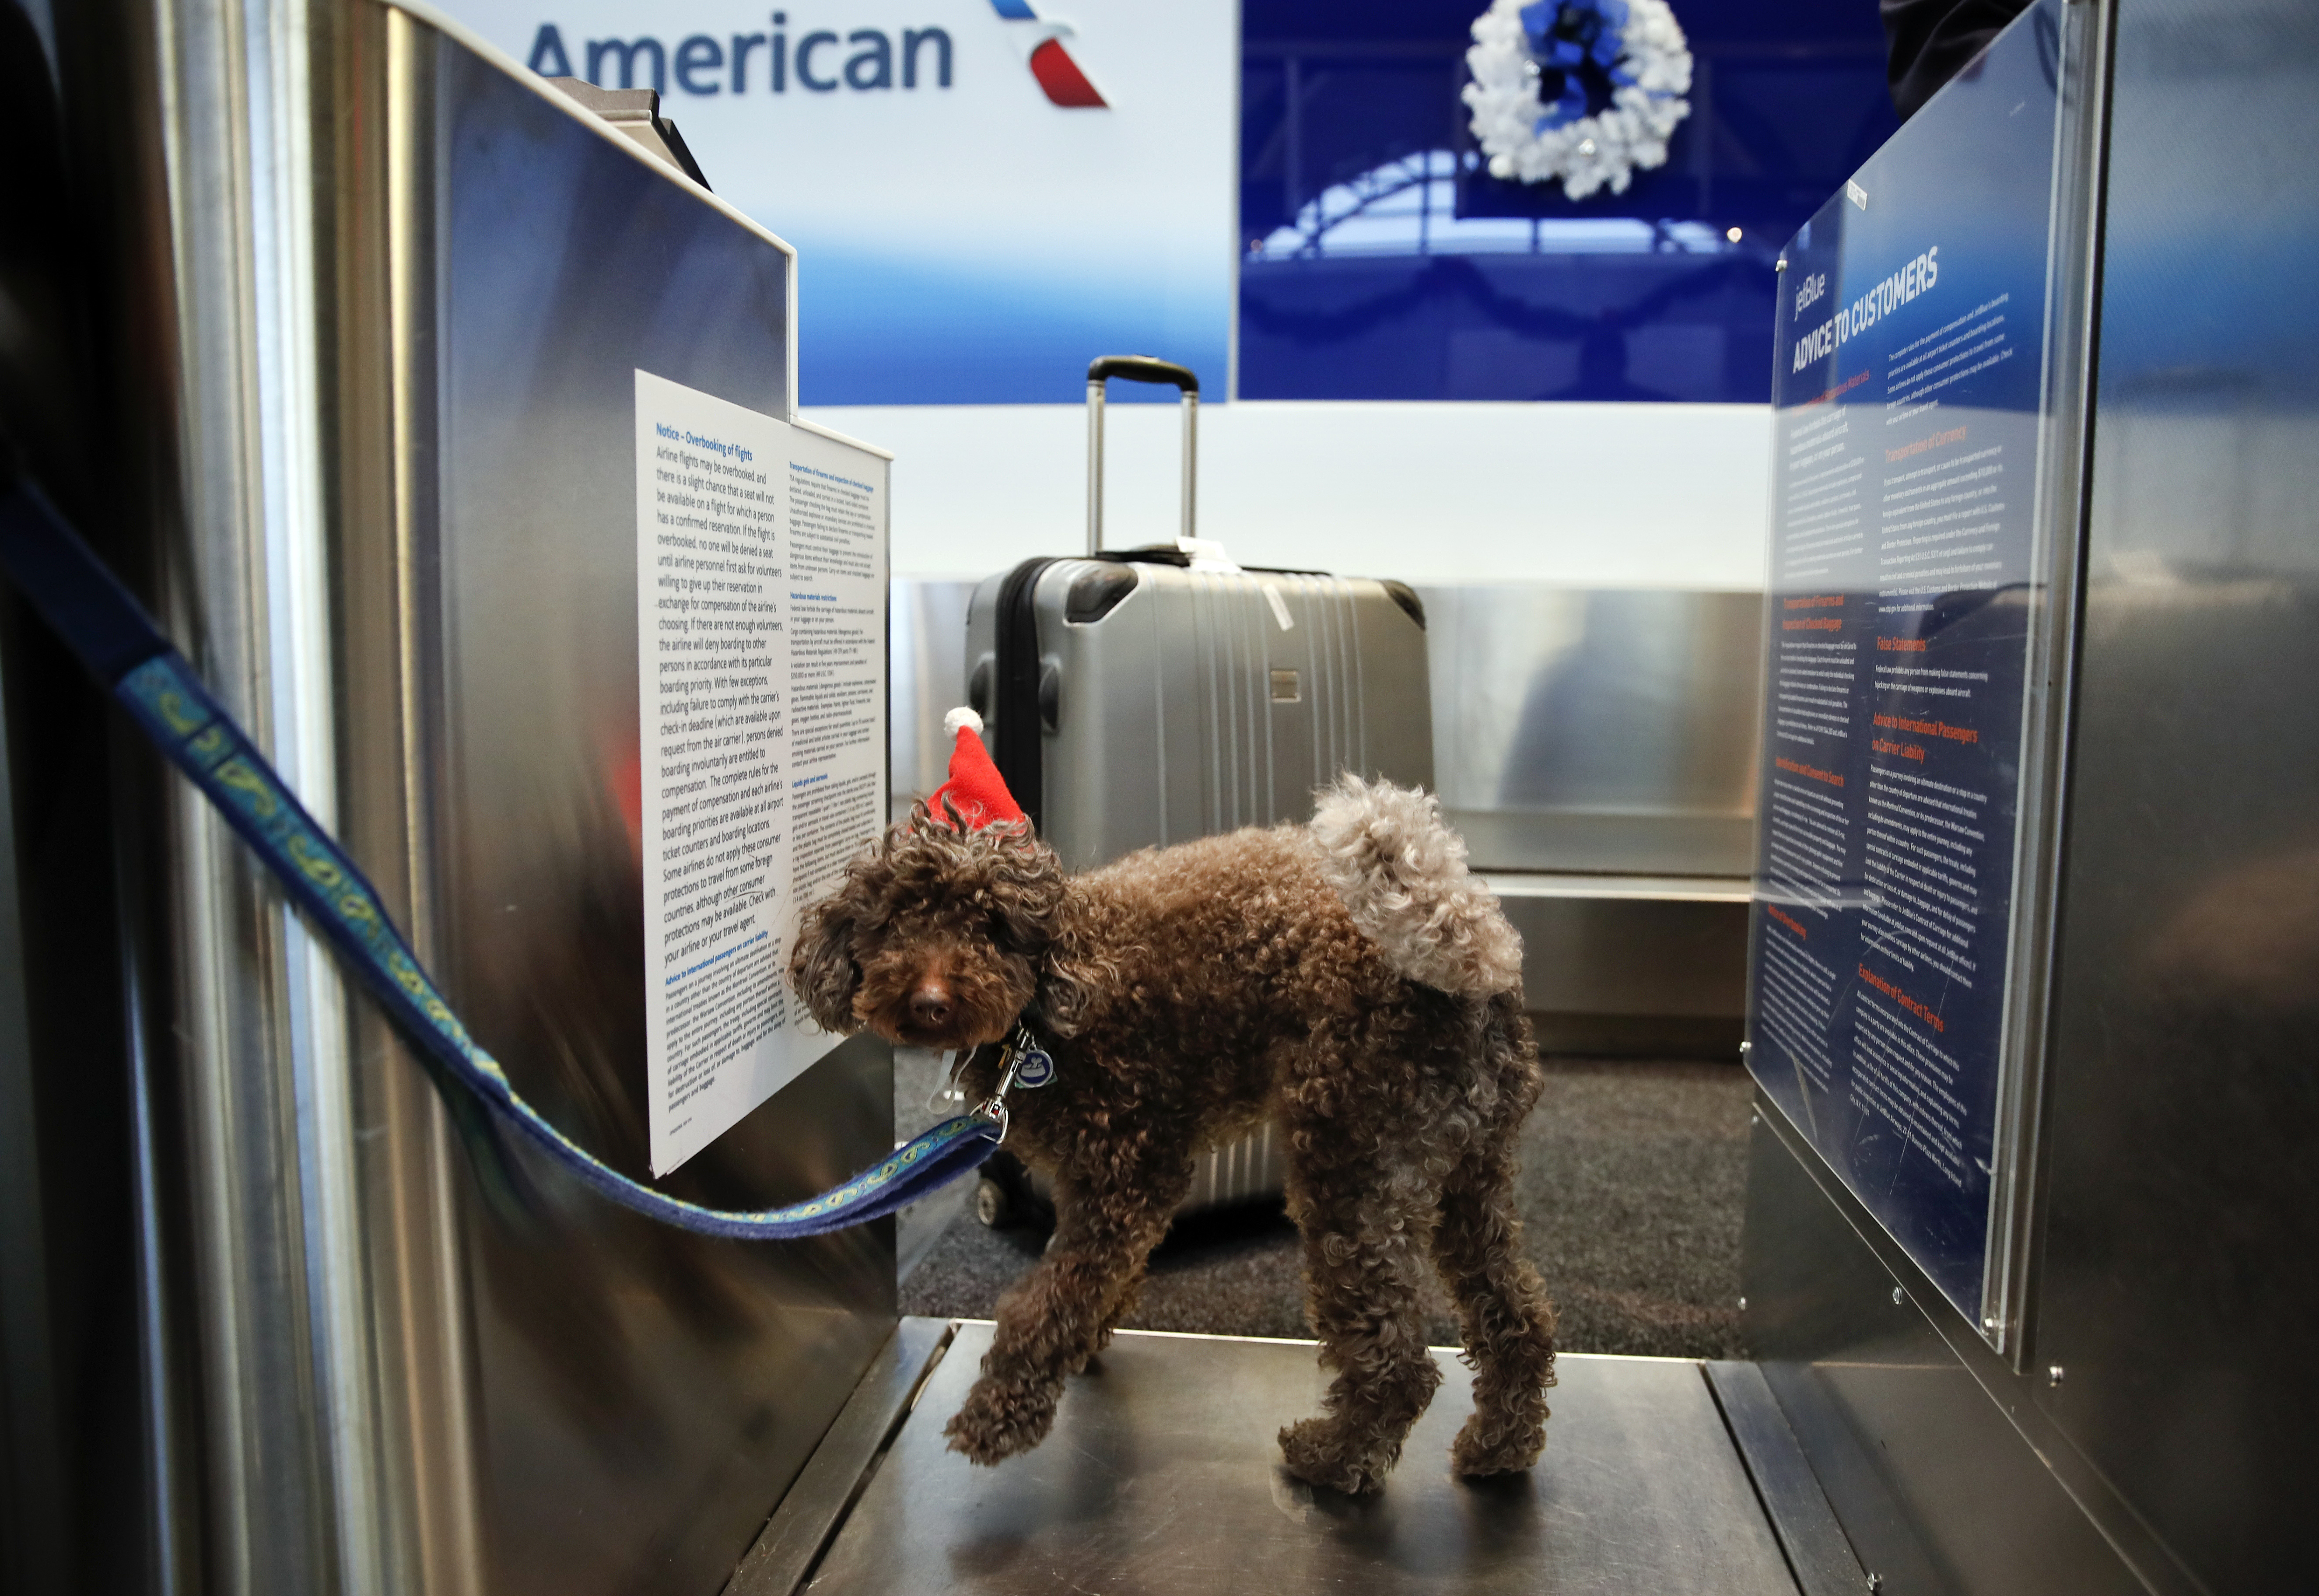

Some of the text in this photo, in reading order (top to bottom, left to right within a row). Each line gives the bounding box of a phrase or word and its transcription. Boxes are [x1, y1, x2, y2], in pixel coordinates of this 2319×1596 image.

[526, 12, 954, 95] American
[1793, 247, 1937, 372] ADVICE TO CUSTOMERS
[1794, 273, 1825, 322] jetBlue
[656, 423, 679, 441] Notice
[686, 431, 726, 457] Overbooking
[727, 443, 734, 456] of
[735, 444, 752, 462] flights
[1885, 426, 1967, 462] Transportation of Currency
[656, 446, 678, 462] Airline
[679, 450, 698, 469] flights
[700, 459, 712, 475] may
[713, 459, 721, 473] be
[756, 472, 766, 484] and
[656, 467, 774, 504] there is a slight chance that a seat will not
[657, 488, 774, 523] be available on a flight for which a person
[657, 510, 669, 524] has
[669, 514, 674, 525] a
[676, 514, 707, 530] confirmed
[743, 524, 747, 536] If
[747, 525, 757, 538] the
[757, 526, 770, 542] flight
[771, 529, 775, 541] is
[658, 554, 781, 578] until airline personnel first ask for volunteers
[699, 540, 707, 550] no
[708, 541, 720, 552] one
[720, 540, 730, 553] will
[732, 541, 739, 554] be
[739, 543, 758, 556] denied
[758, 547, 762, 557] a
[763, 548, 773, 558] seat
[658, 574, 763, 594] willing to give up their reservation in
[658, 596, 776, 613] exchange for compensation of the airline's
[690, 616, 695, 630] If
[696, 617, 712, 630] there
[713, 620, 723, 630] are
[724, 620, 734, 631] not
[735, 619, 755, 634] enough
[1877, 636, 1926, 651] False Statements
[1875, 664, 1886, 673] Federal
[1891, 666, 1904, 675] prohibits
[1909, 668, 1920, 676] person
[1920, 667, 1928, 676] from
[1928, 668, 1941, 679] making
[1940, 668, 1949, 677] false
[660, 710, 781, 735] check-in deadline (which are available upon
[1873, 714, 1977, 744] Advice to International Passengers
[1871, 738, 1925, 763] on Carrier Liability
[792, 779, 803, 788] Liquids
[662, 846, 680, 861] ticket
[681, 838, 708, 855] counters
[709, 831, 720, 847] and
[722, 826, 746, 843] boarding
[663, 833, 781, 882] Some airlines do not apply these consumer
[664, 949, 680, 968] your
[680, 940, 700, 957] airline
[701, 936, 708, 947] or
[708, 929, 722, 948] your
[723, 919, 739, 937] travel
[665, 930, 768, 986] Advice to international passengers on carrier liability
[1859, 963, 1944, 1032] Explanation of Contract Terms
